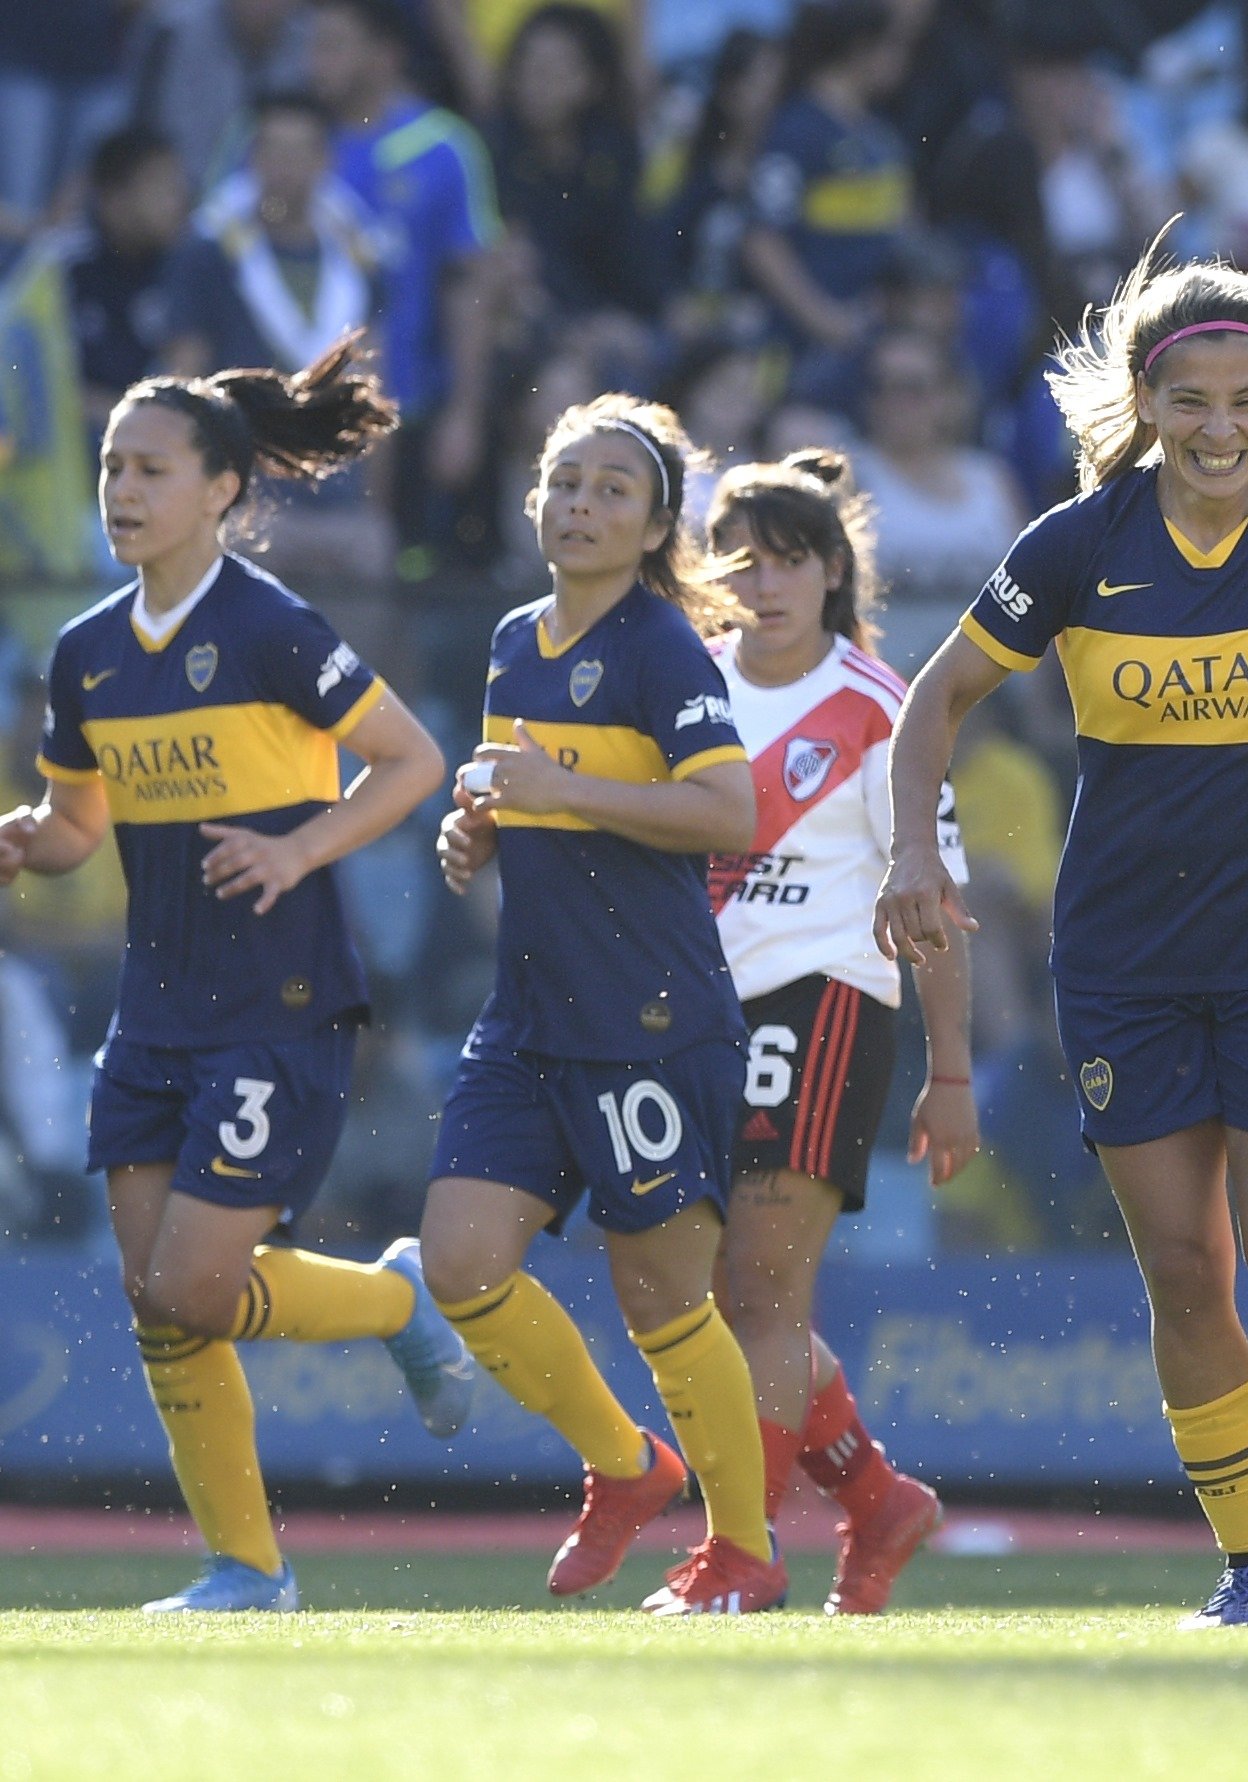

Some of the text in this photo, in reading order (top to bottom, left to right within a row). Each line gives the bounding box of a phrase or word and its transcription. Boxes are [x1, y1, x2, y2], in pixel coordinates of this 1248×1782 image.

[989, 566, 1034, 615] RUS
[99, 734, 219, 788] QATAR
[135, 775, 227, 802] AIRWAYS
[743, 1024, 799, 1108] 6
[218, 1076, 276, 1160] 3
[597, 1079, 683, 1175] 10
